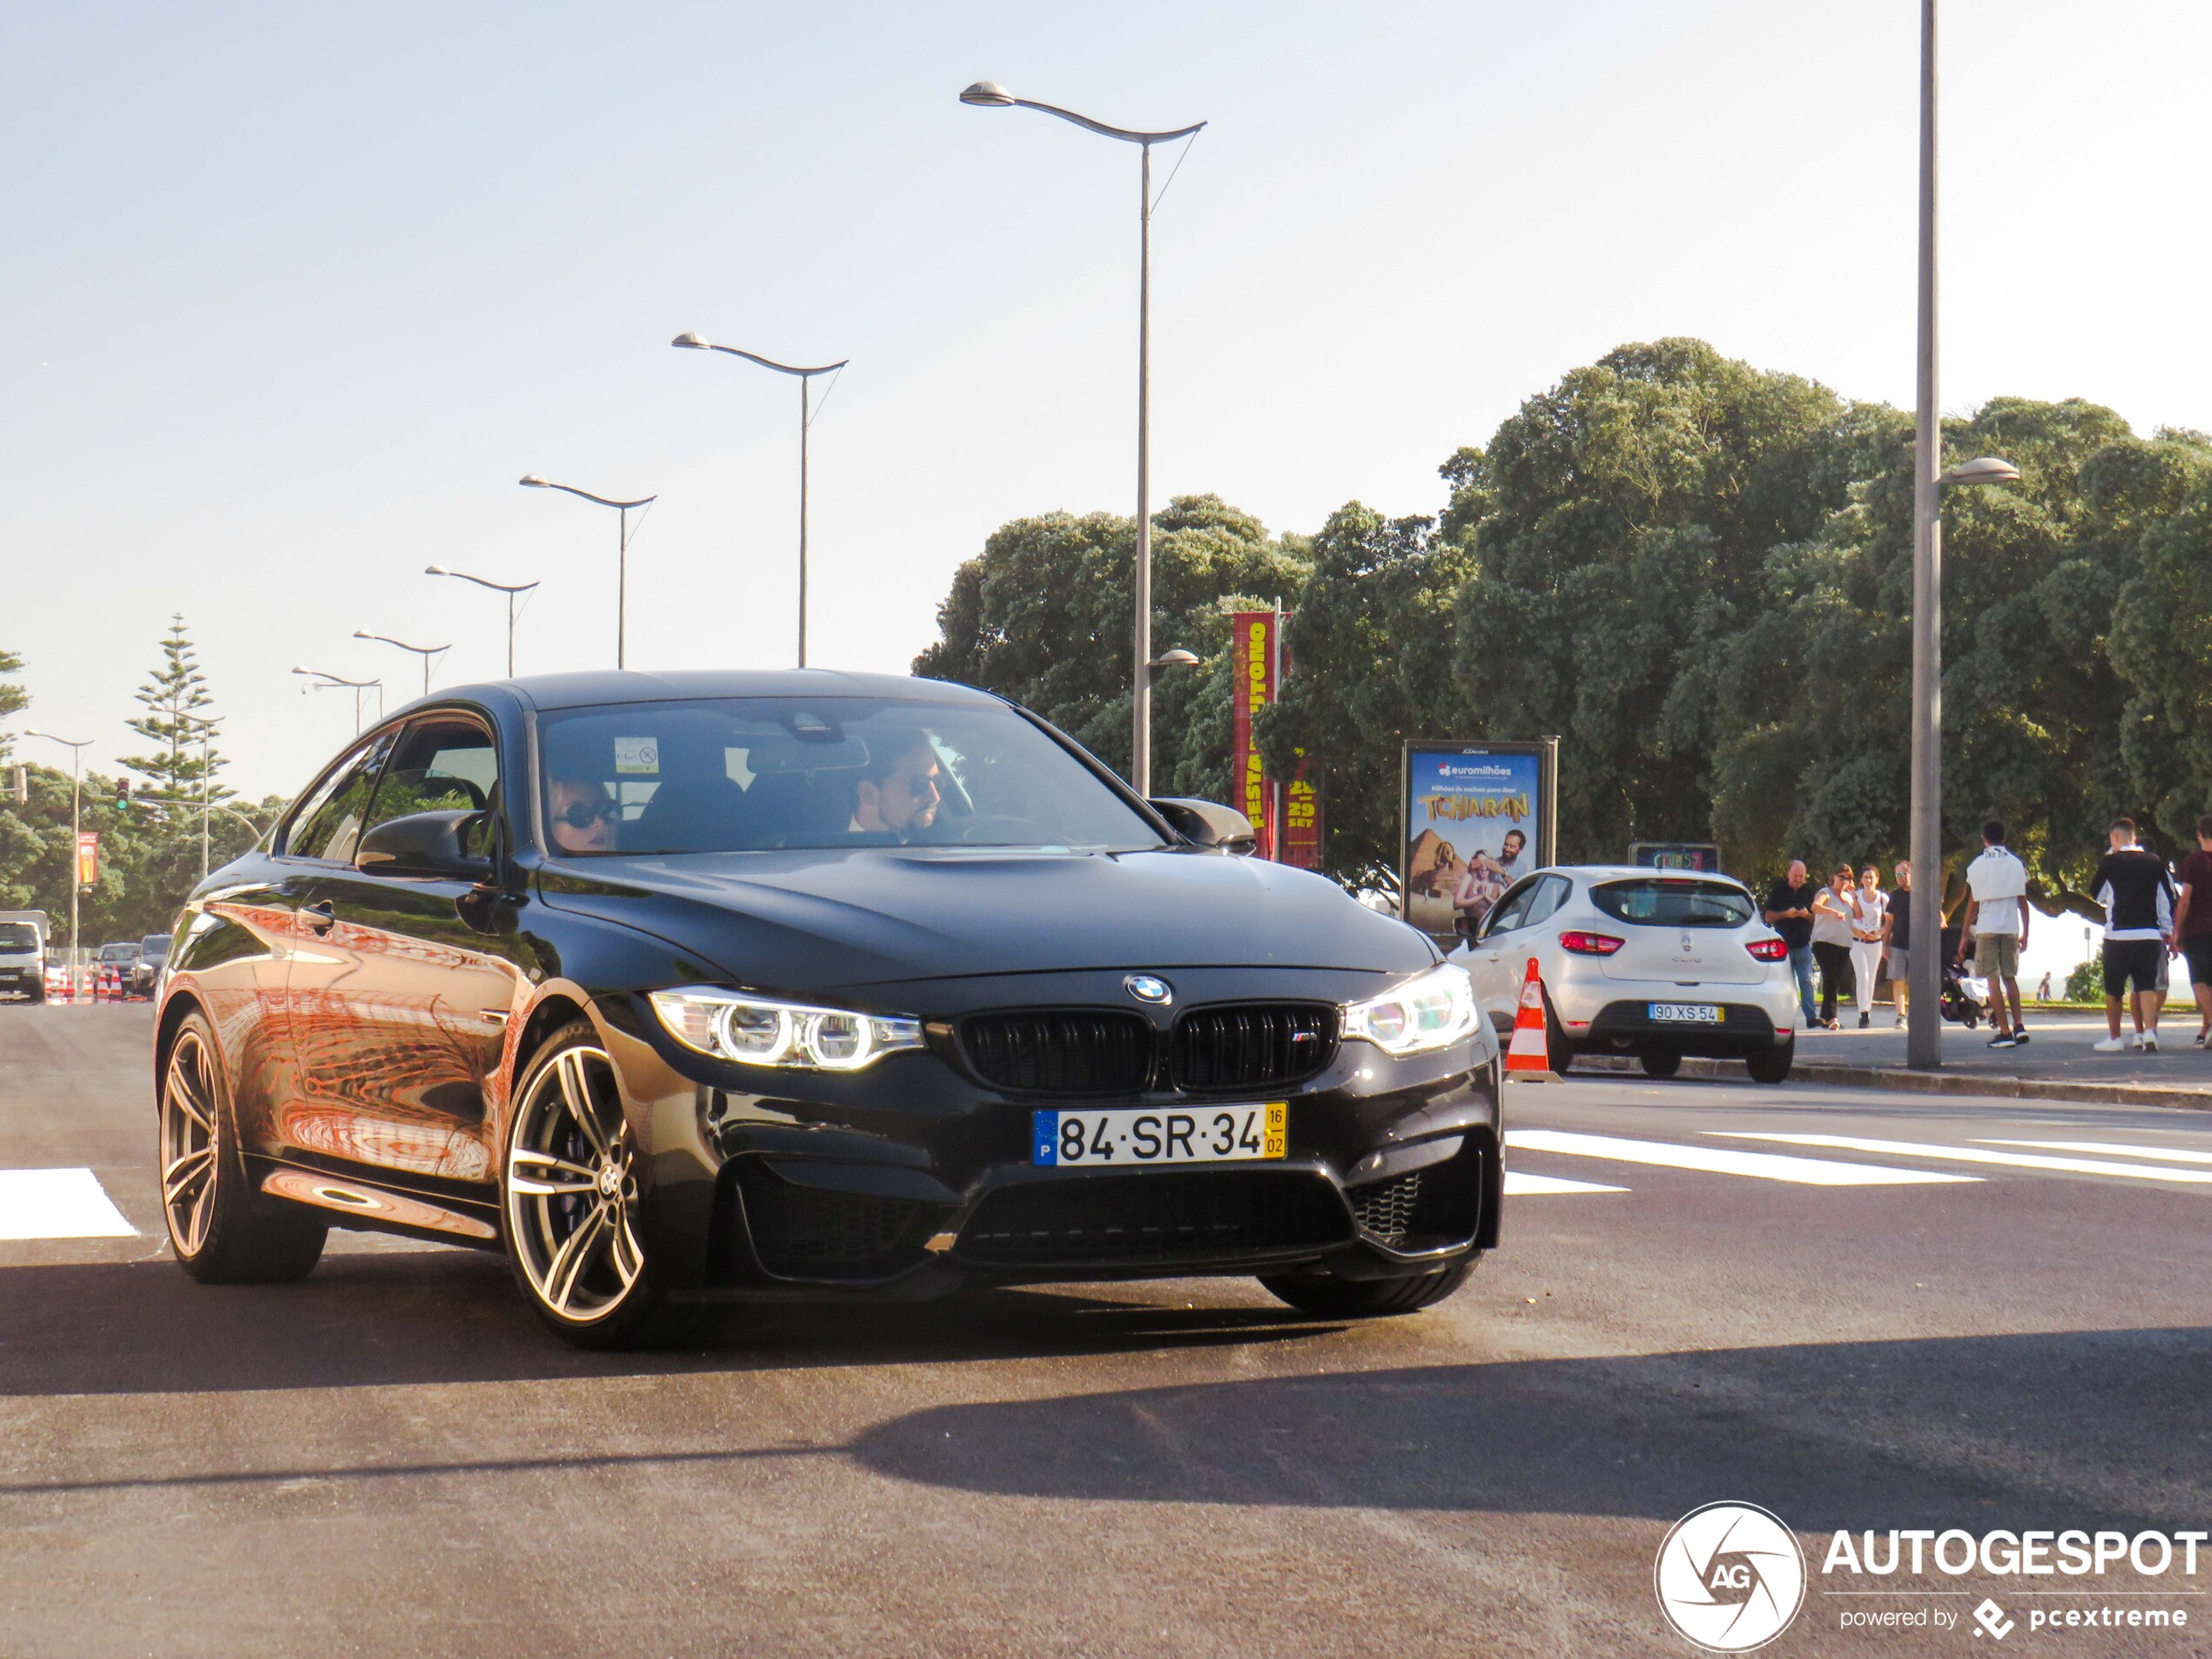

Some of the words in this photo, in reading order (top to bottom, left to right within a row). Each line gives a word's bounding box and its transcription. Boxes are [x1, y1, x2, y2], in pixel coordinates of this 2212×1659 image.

[1452, 765, 1511, 775] euromilhões
[1245, 754, 1265, 830] FESTA
[1288, 802, 1315, 817] 29
[1270, 1109, 1283, 1123] 16
[1040, 1144, 1051, 1157] P
[1267, 1138, 1283, 1152] 02
